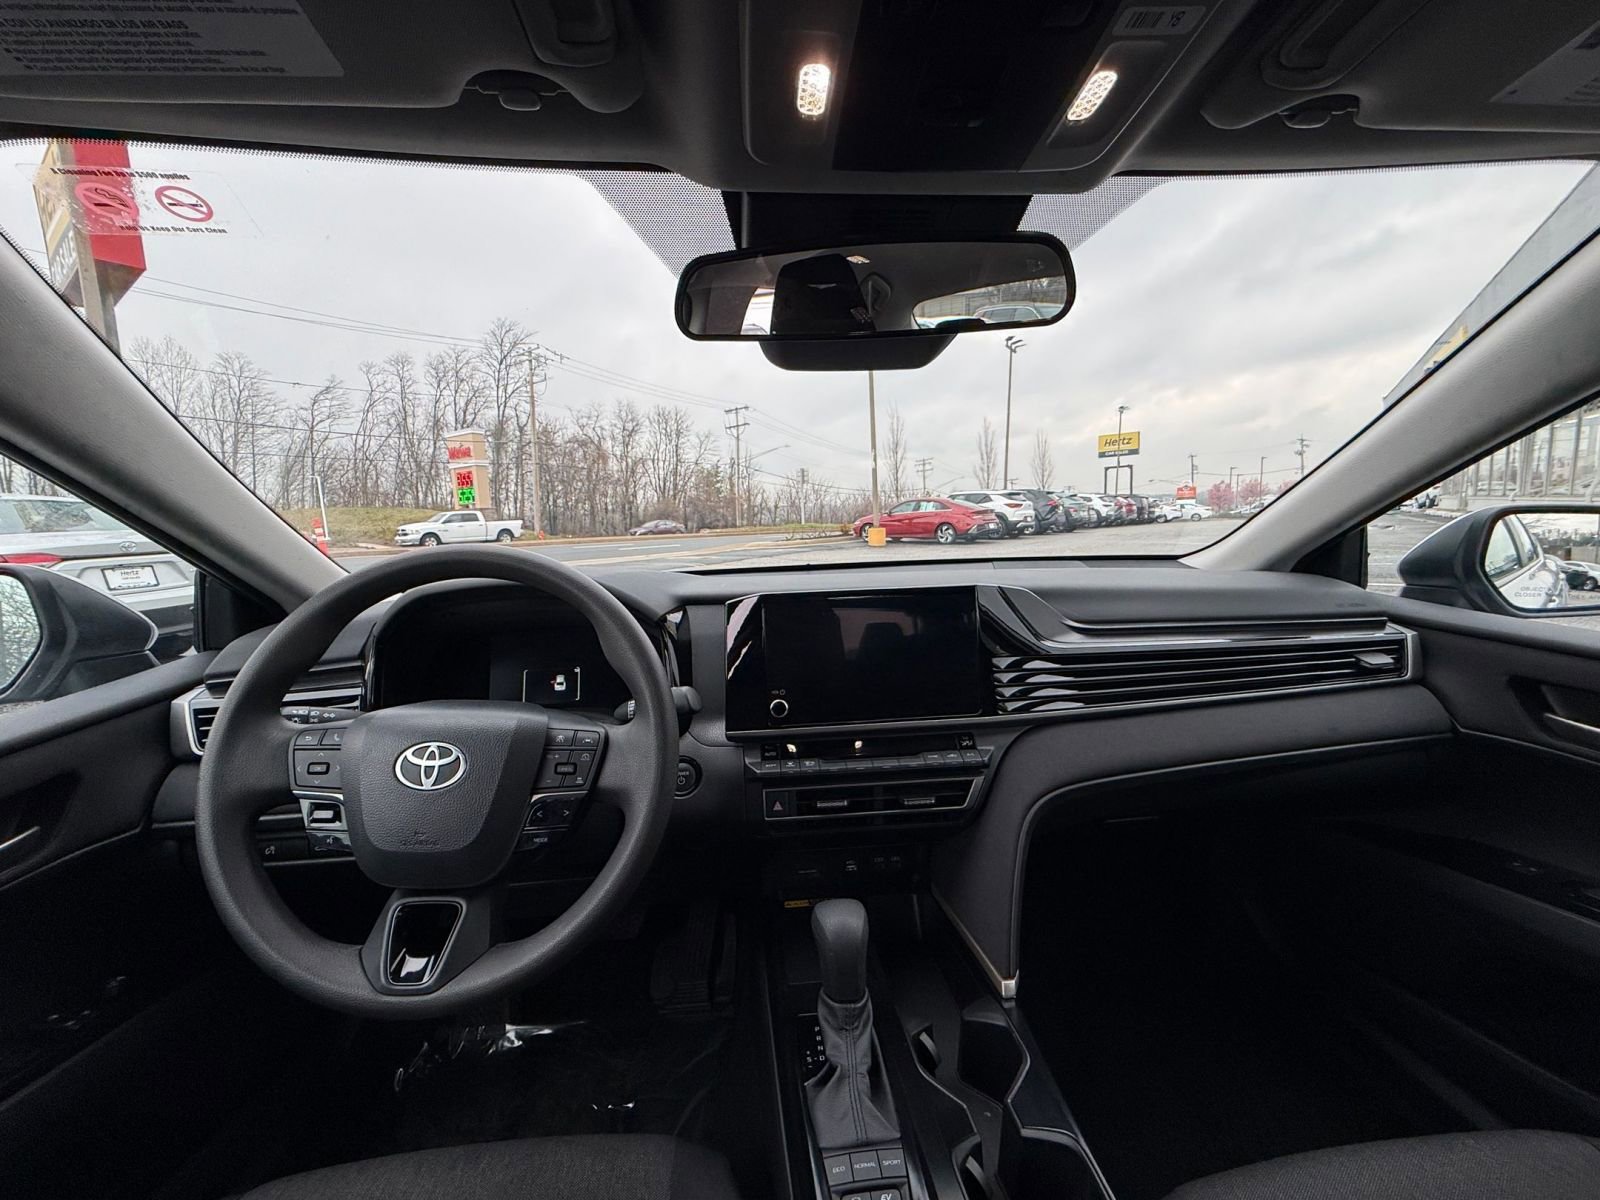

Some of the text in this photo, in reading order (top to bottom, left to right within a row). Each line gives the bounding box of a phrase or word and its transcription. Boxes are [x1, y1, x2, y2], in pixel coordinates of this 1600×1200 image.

[1104, 437, 1133, 447] Hertz
[832, 1166, 846, 1174] ECO
[854, 1161, 876, 1169] NORMAL
